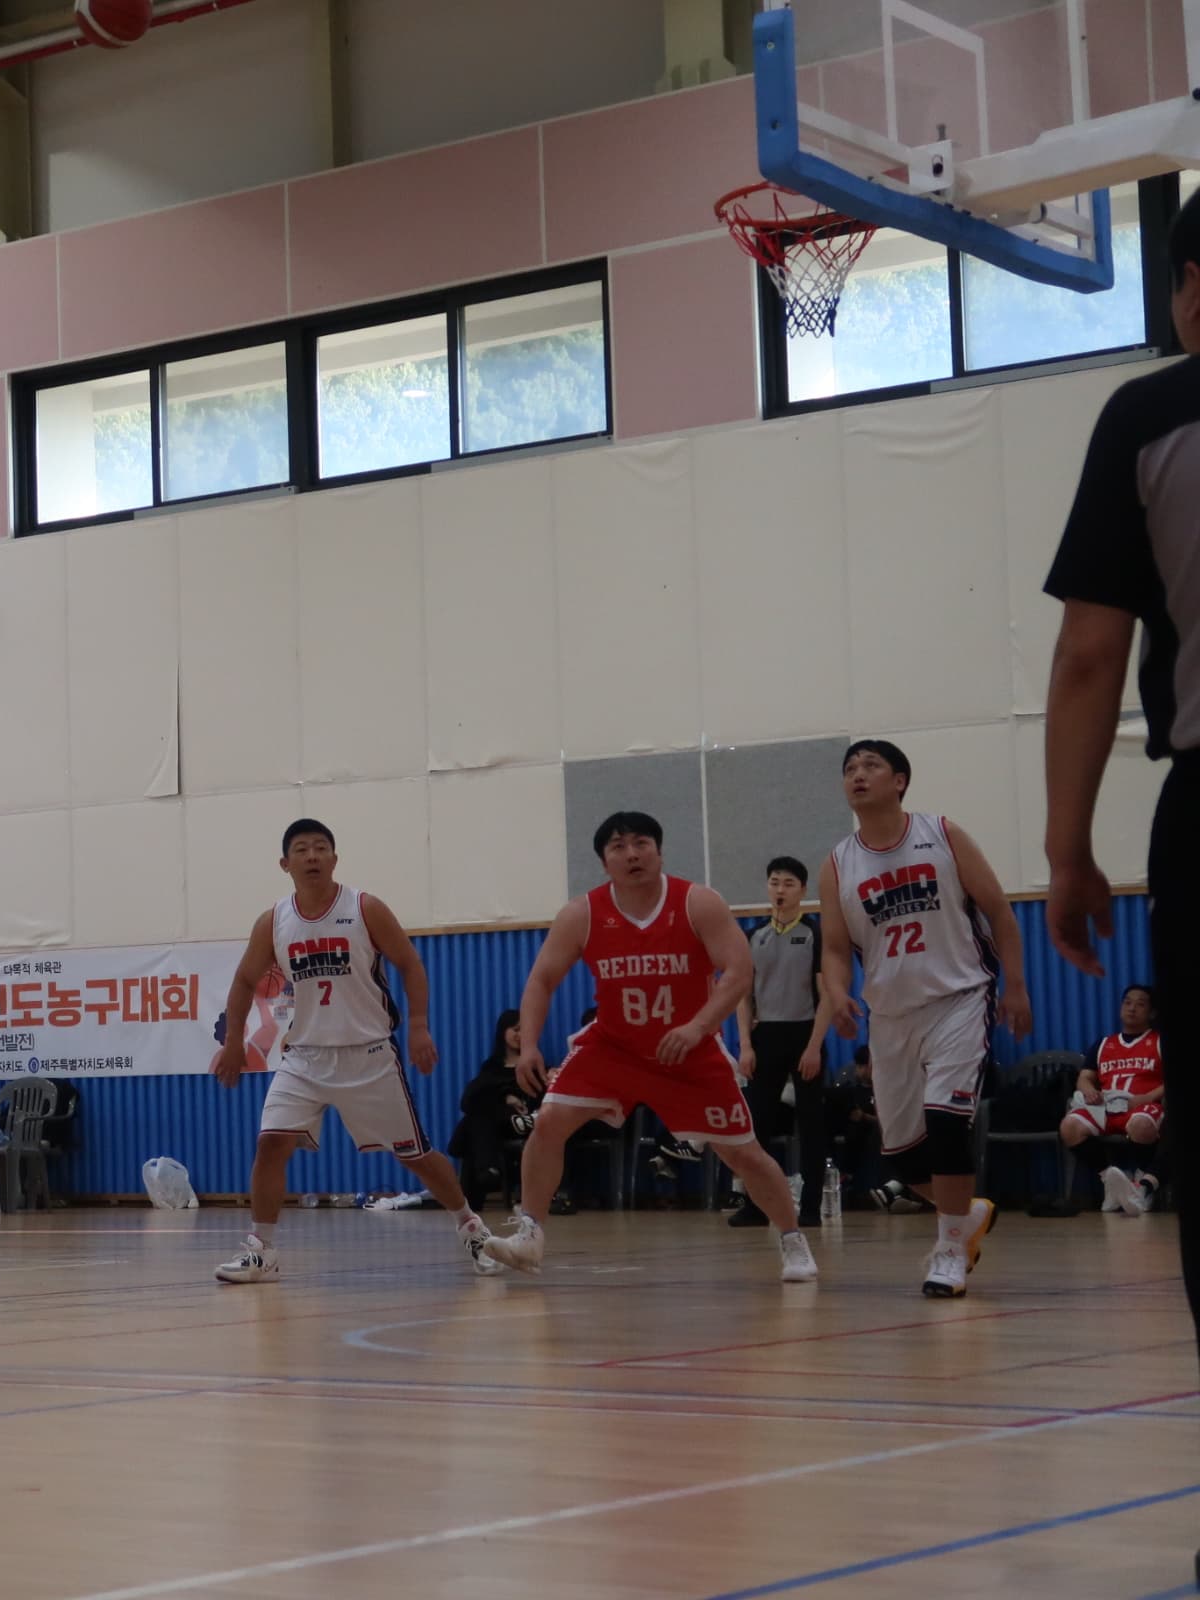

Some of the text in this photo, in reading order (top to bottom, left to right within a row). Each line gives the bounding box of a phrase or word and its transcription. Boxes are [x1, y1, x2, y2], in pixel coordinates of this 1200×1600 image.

[884, 921, 926, 957] 72
[288, 936, 351, 972] CMD
[597, 953, 690, 980] REDEEM
[3, 963, 31, 976] 다목적
[34, 961, 63, 975] 체육관
[317, 980, 333, 1006] 7
[621, 984, 676, 1026] 84
[39, 1056, 133, 1072] 제주특별자치도체육회
[1100, 1057, 1156, 1074] REDEEM
[1111, 1073, 1136, 1093] 17
[704, 1103, 748, 1128] 84
